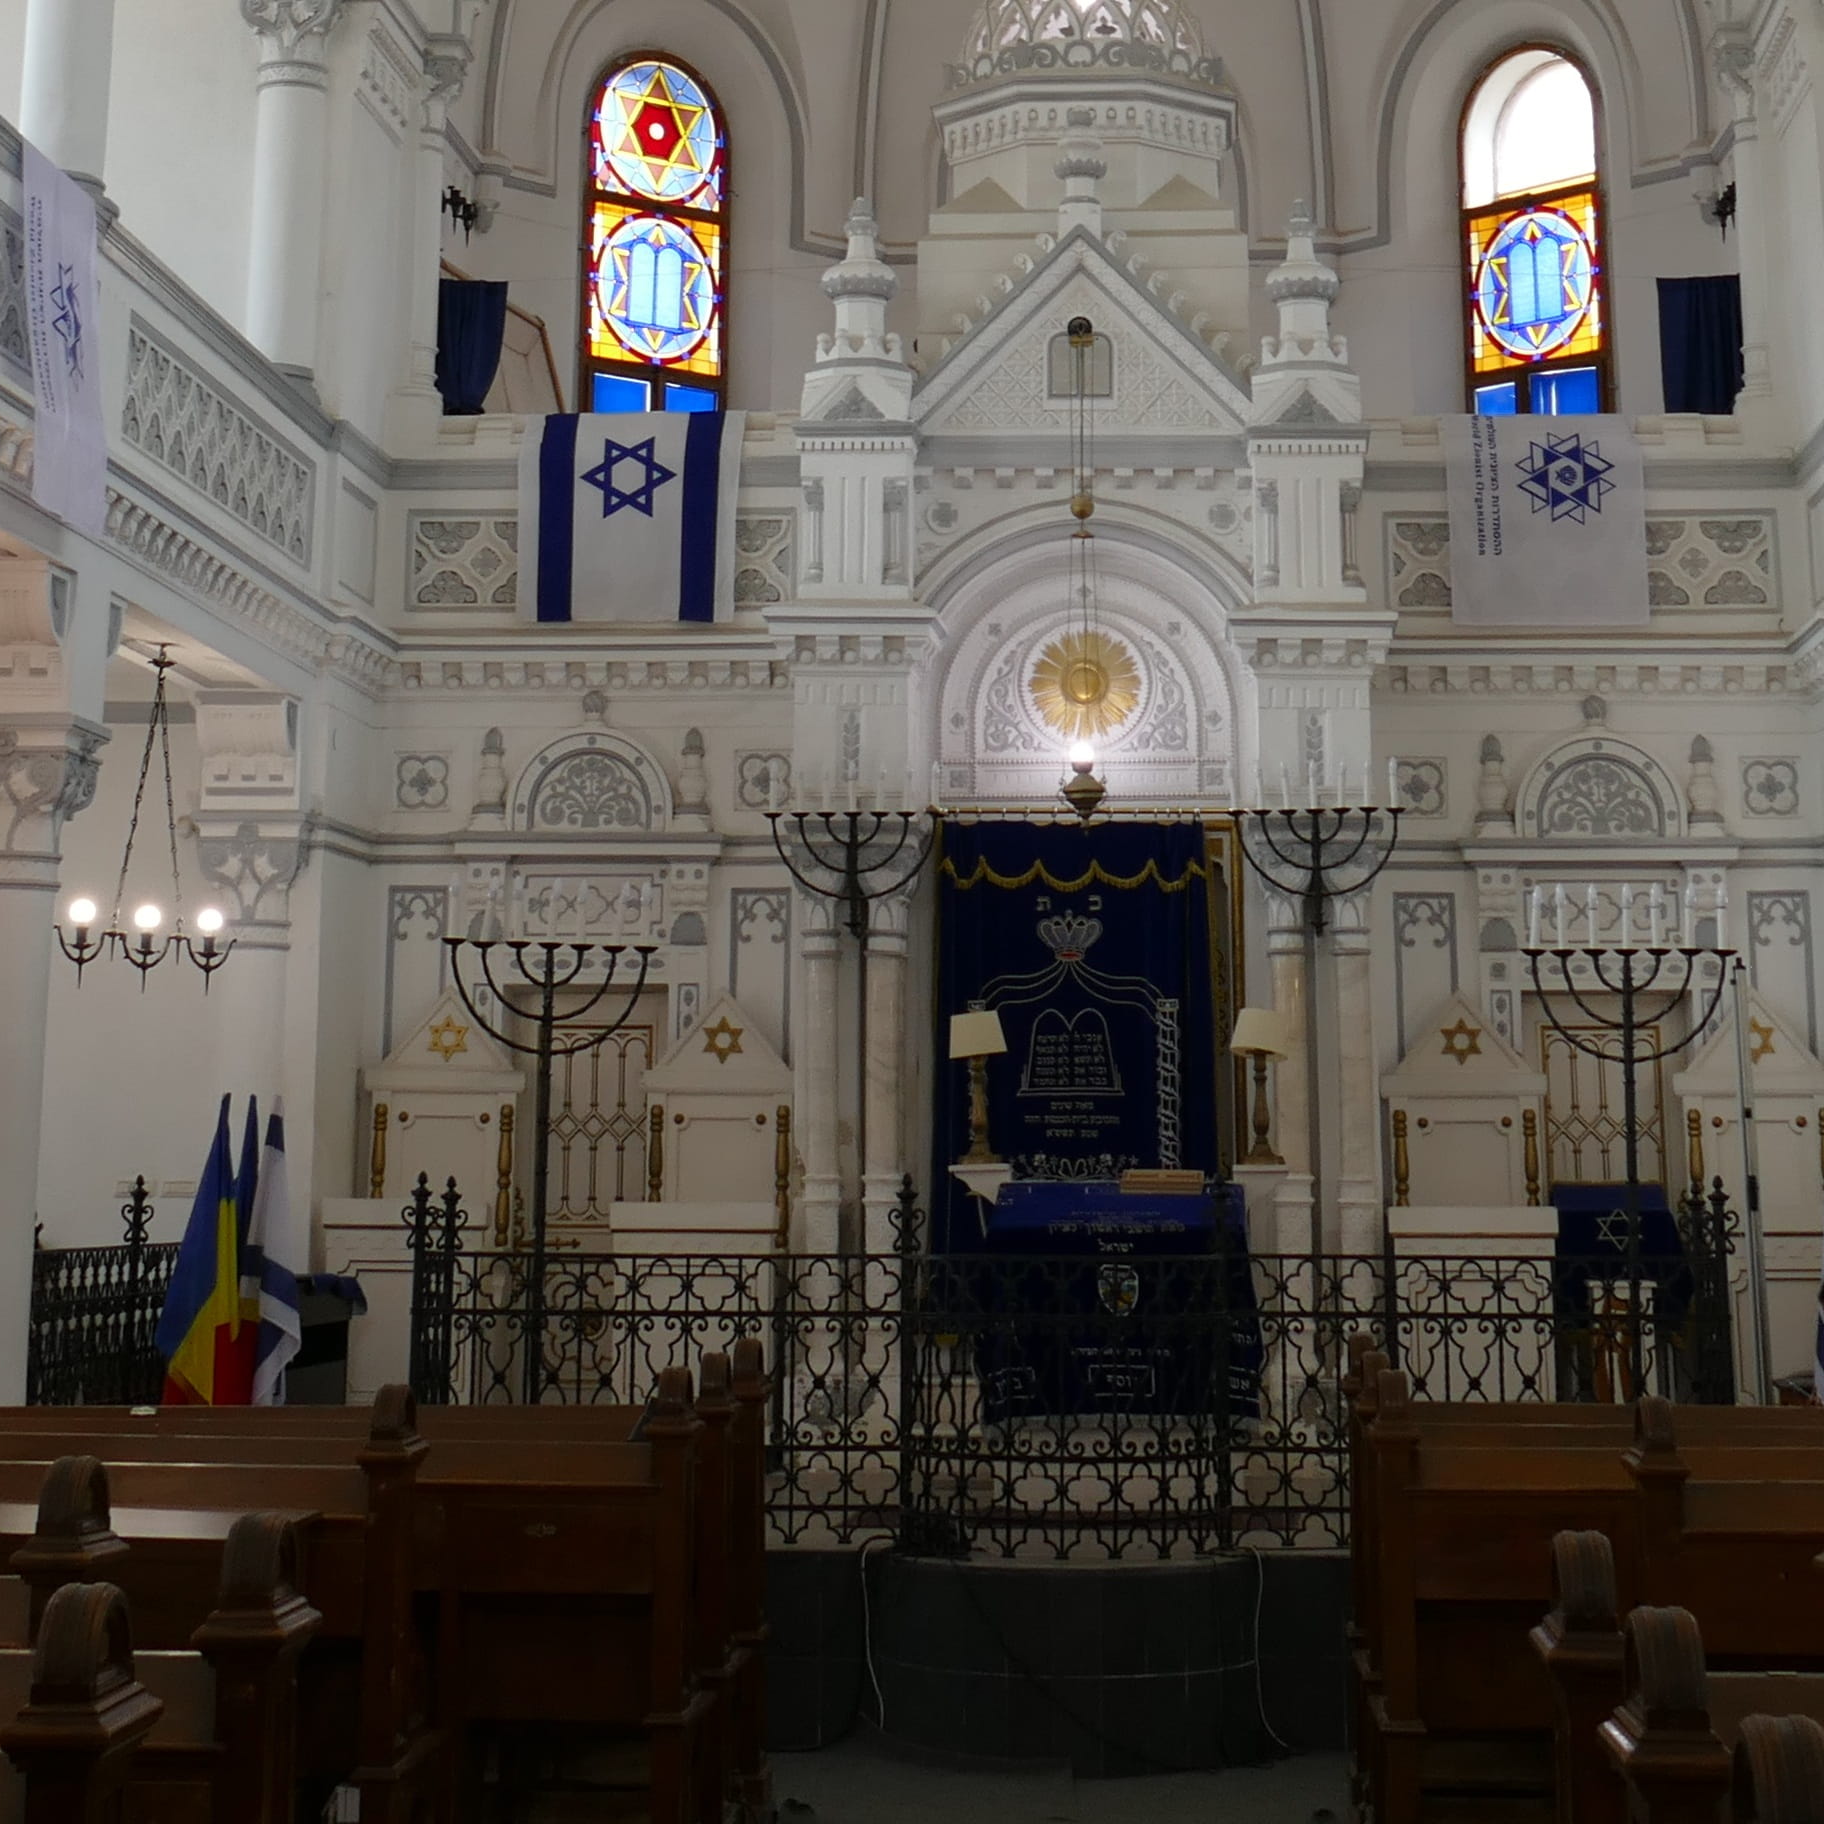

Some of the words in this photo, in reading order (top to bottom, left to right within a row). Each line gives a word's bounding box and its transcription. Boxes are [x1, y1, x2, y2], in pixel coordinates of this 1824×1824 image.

[1473, 442, 1483, 478] Zionist
[1474, 482, 1487, 556] Organization
[1491, 495, 1503, 556] ההסתדרות
